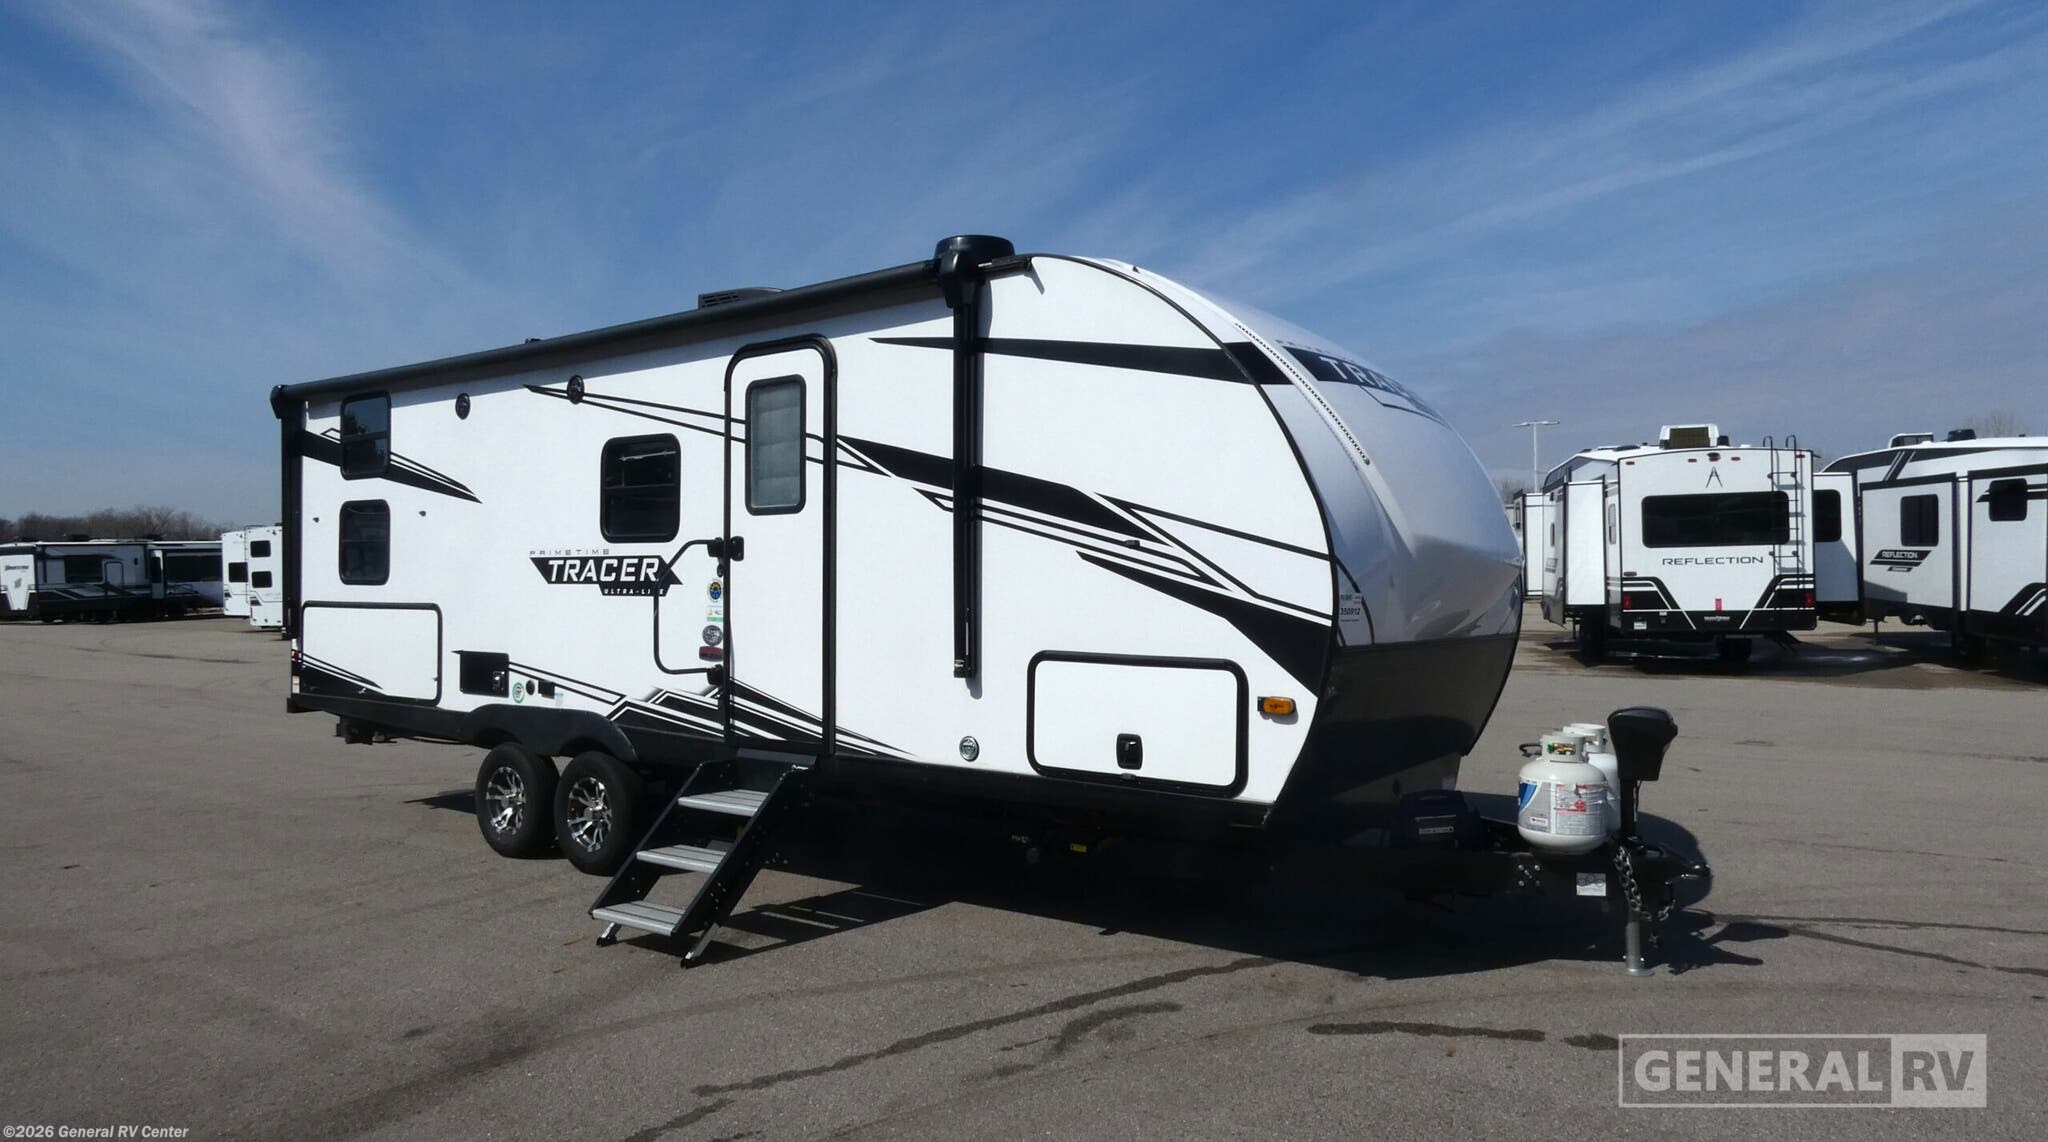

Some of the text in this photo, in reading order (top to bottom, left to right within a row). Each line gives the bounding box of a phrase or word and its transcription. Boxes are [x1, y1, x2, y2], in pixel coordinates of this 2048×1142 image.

[1881, 551, 1919, 559] REFLECTION
[1662, 556, 1764, 566] REFLECTION
[548, 558, 659, 582] TRACER
